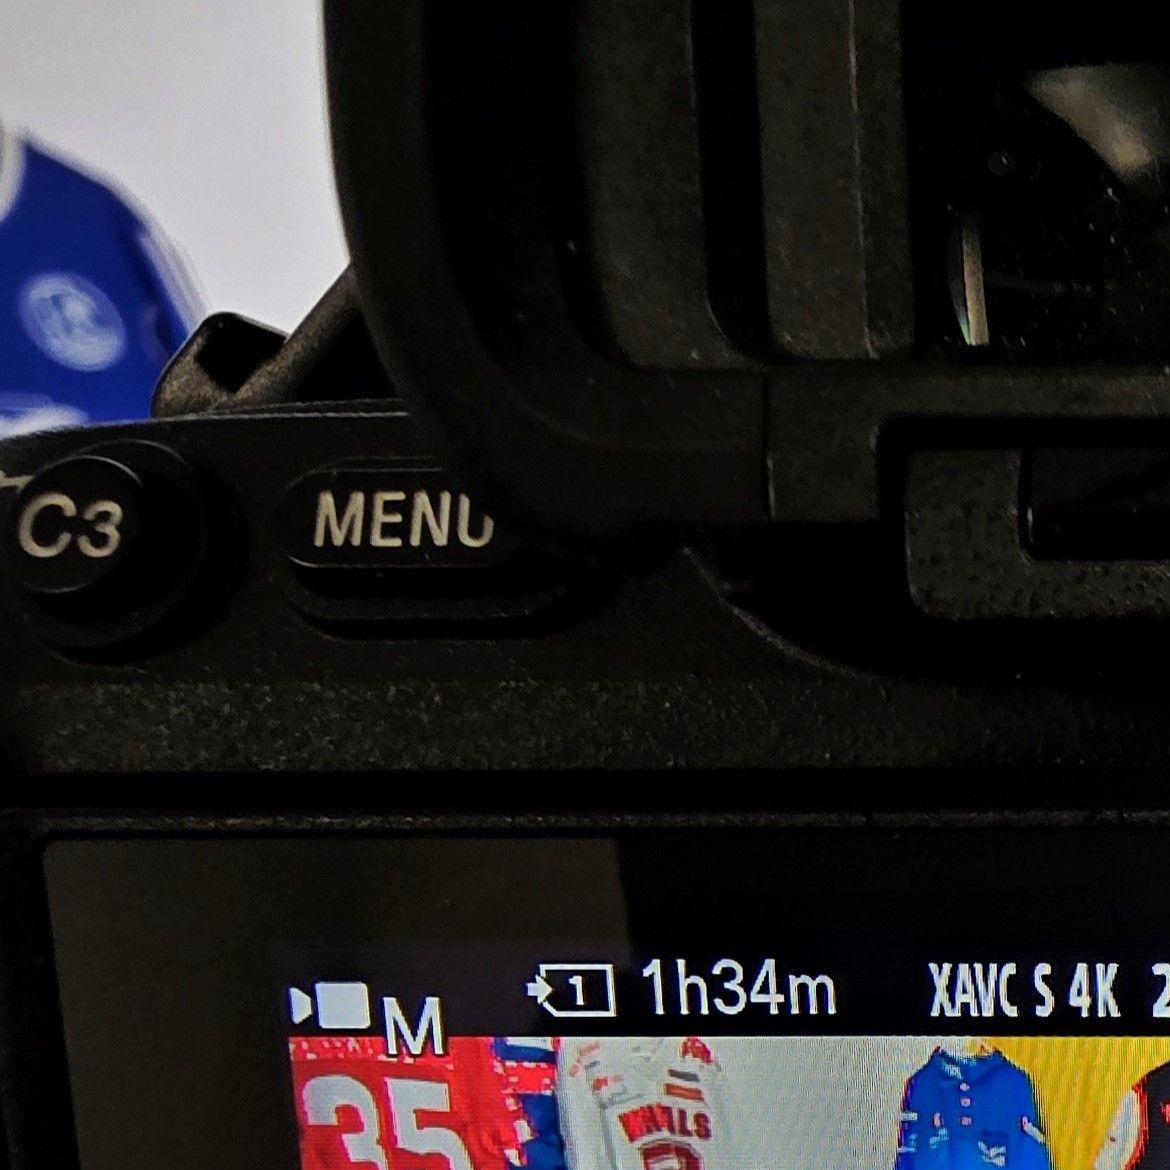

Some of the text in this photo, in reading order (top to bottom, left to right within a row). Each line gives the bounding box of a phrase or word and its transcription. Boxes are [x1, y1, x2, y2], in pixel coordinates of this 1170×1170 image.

[18, 492, 123, 558] C3
[313, 489, 494, 548] MENU
[569, 975, 585, 1006] 1
[642, 958, 837, 1015] 1h34m
[927, 962, 1019, 1018] XAVC
[1033, 962, 1055, 1018] S
[1068, 962, 1122, 1019] 4K
[383, 997, 445, 1055] M
